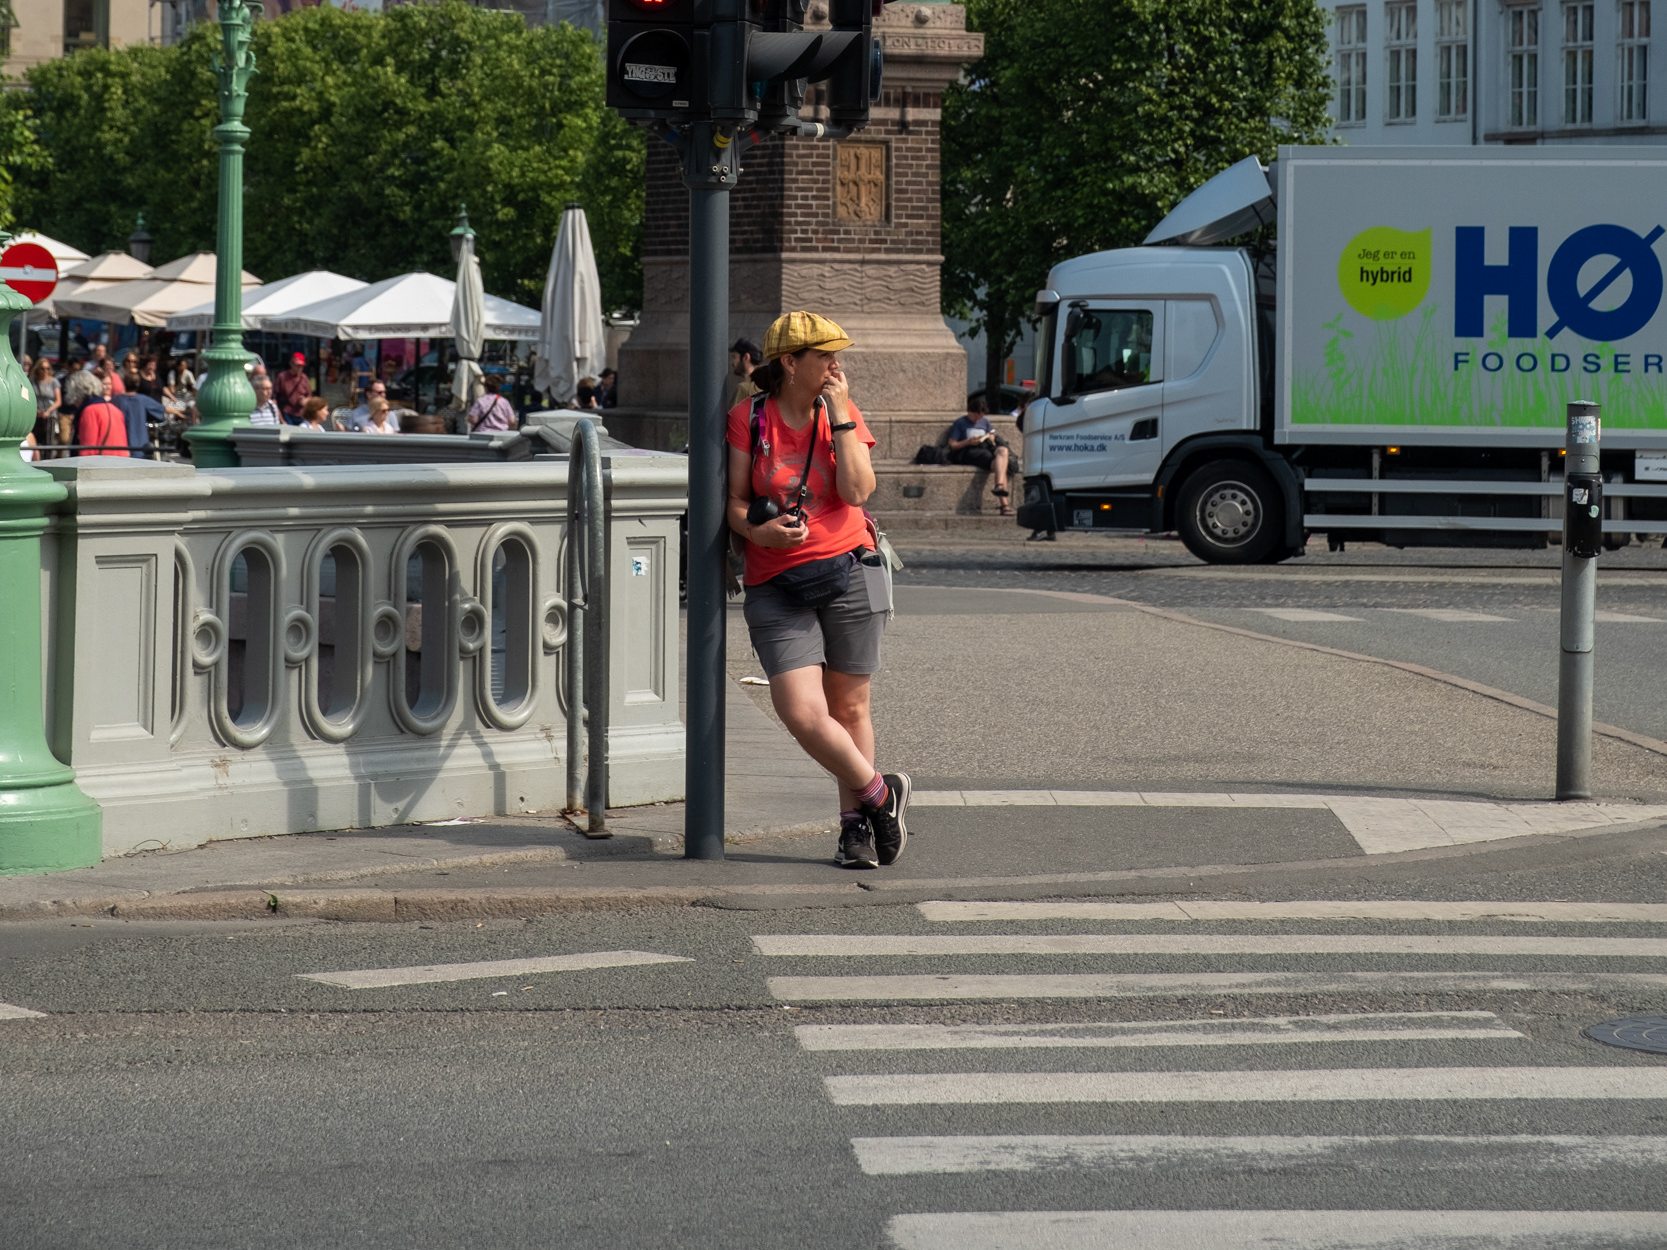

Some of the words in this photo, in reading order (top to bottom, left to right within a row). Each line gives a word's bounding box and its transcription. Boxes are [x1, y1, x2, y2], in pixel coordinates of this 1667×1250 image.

[1357, 248, 1380, 262] Jeg
[1383, 250, 1397, 260] er
[1400, 250, 1416, 260] en
[1359, 266, 1412, 286] hybrid
[1454, 223, 1666, 342] HØ
[1453, 351, 1664, 374] FOODSER
[1048, 443, 1107, 452] www.hoka.dk
